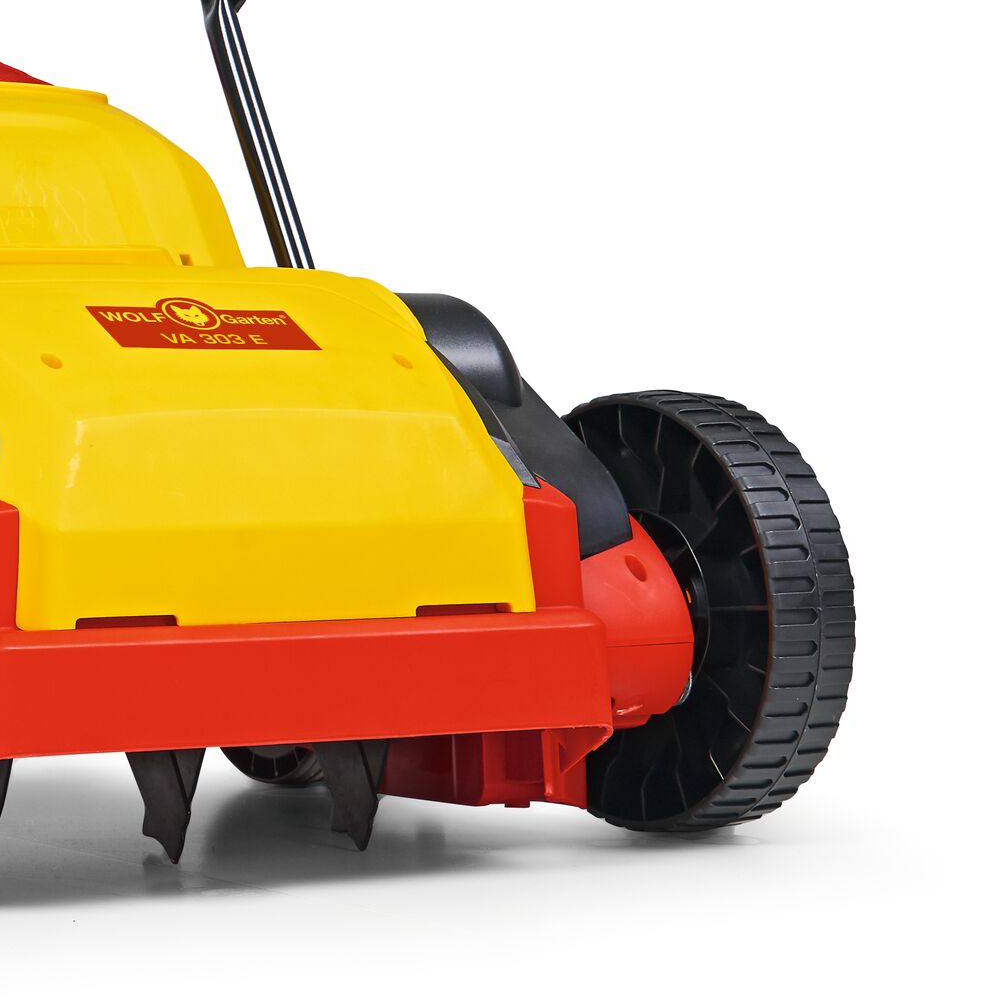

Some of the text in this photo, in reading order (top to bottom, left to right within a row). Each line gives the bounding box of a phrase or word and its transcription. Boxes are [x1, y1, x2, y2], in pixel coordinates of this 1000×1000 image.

[98, 311, 164, 323] WOLF
[160, 333, 268, 345] VA 303 E
